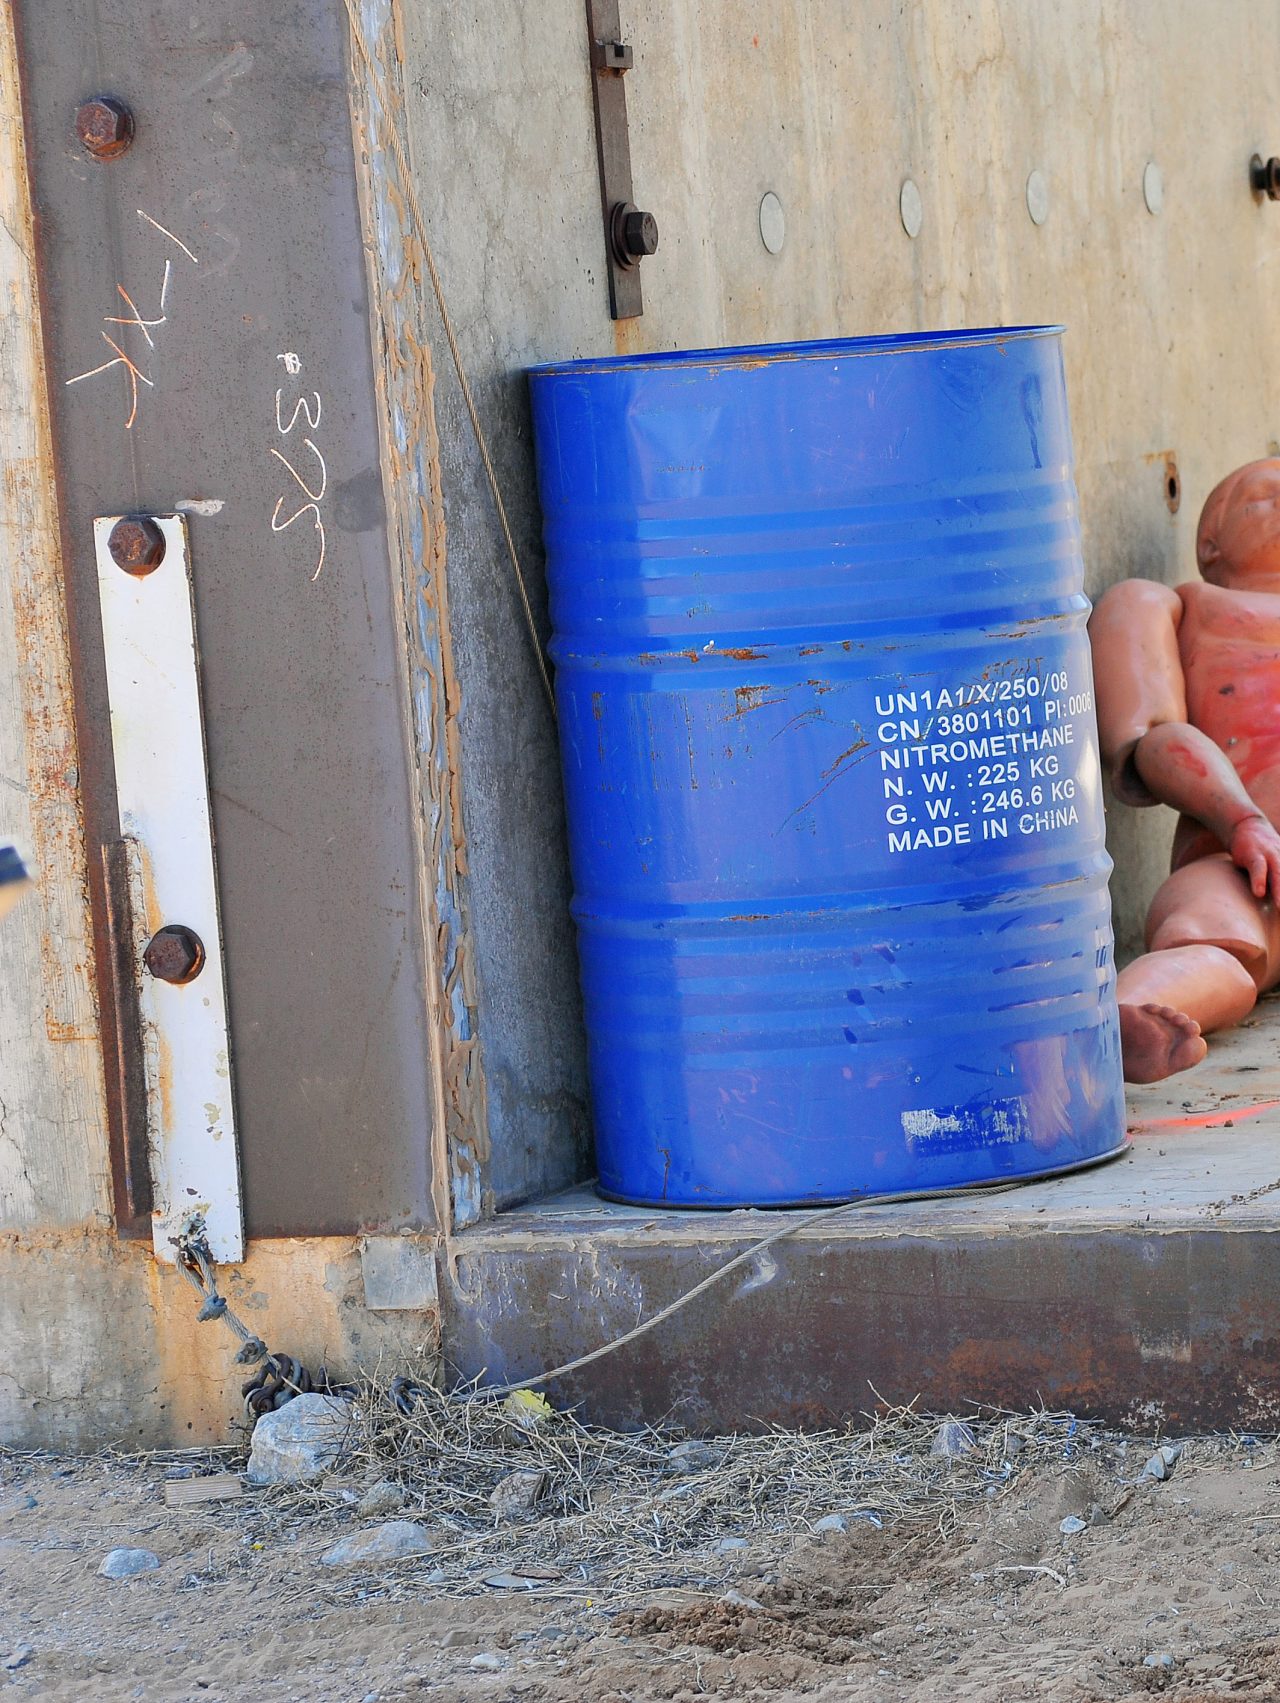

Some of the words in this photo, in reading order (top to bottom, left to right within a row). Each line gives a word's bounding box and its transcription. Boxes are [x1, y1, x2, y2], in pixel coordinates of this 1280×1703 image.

[877, 704, 1032, 743] CN/3801101
[880, 724, 1074, 771] NITROMETHANE
[883, 777, 913, 798] N.
[922, 771, 956, 793] W.
[1030, 755, 1058, 779] KG
[886, 804, 916, 825] G.
[925, 798, 959, 820] W.
[1051, 779, 1075, 802] KG
[888, 823, 971, 853] MADE
[982, 817, 1008, 840] IN
[1019, 805, 1079, 835] CHINA
